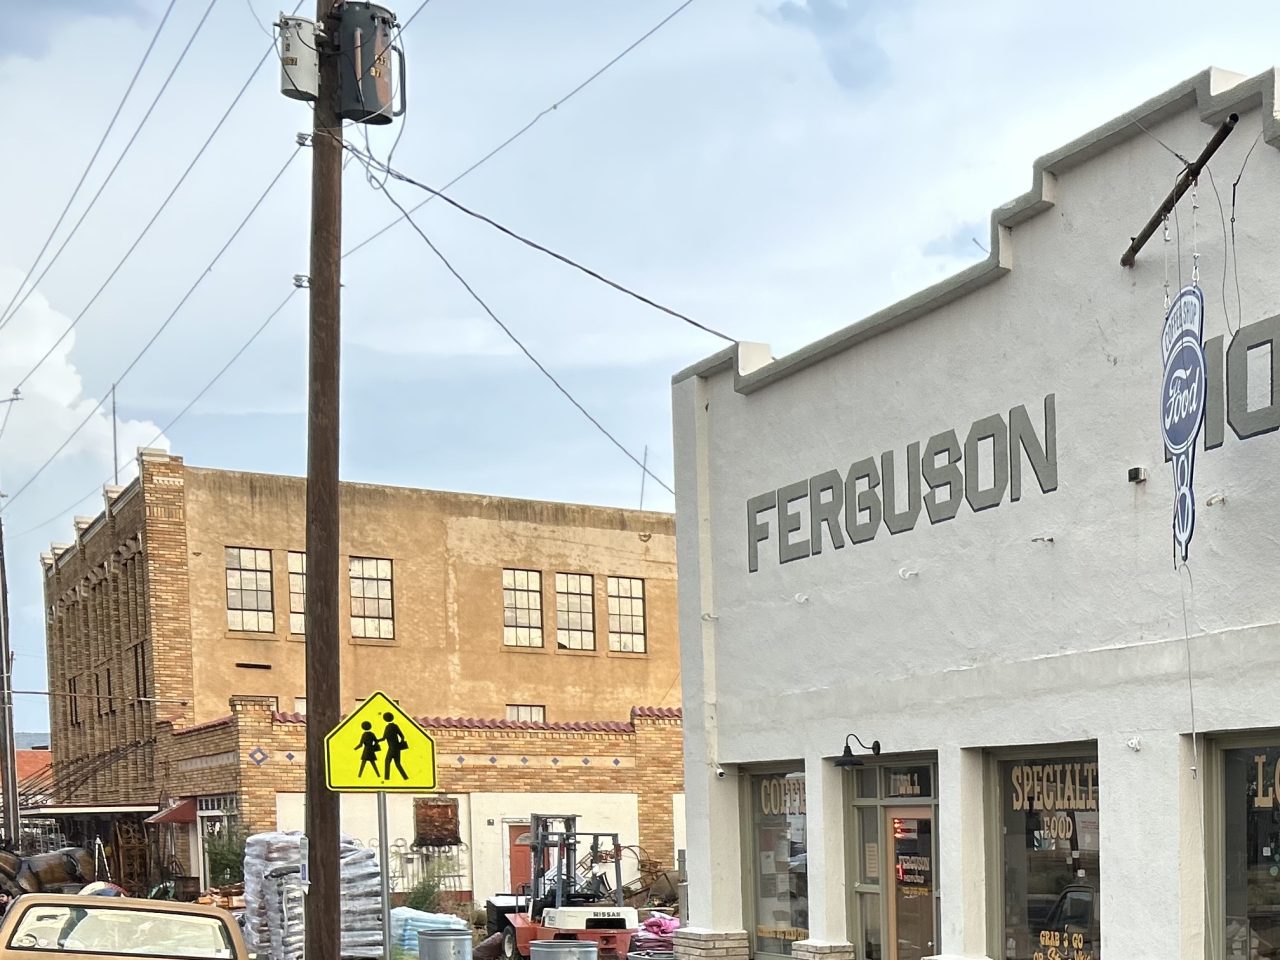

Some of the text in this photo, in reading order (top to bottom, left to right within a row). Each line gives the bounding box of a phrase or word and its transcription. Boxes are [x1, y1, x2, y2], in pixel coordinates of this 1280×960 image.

[747, 393, 1058, 573] FERGUSON
[1043, 816, 1074, 839] FOOD
[1040, 930, 1060, 947] GRAB
[1072, 933, 1084, 950] GO
